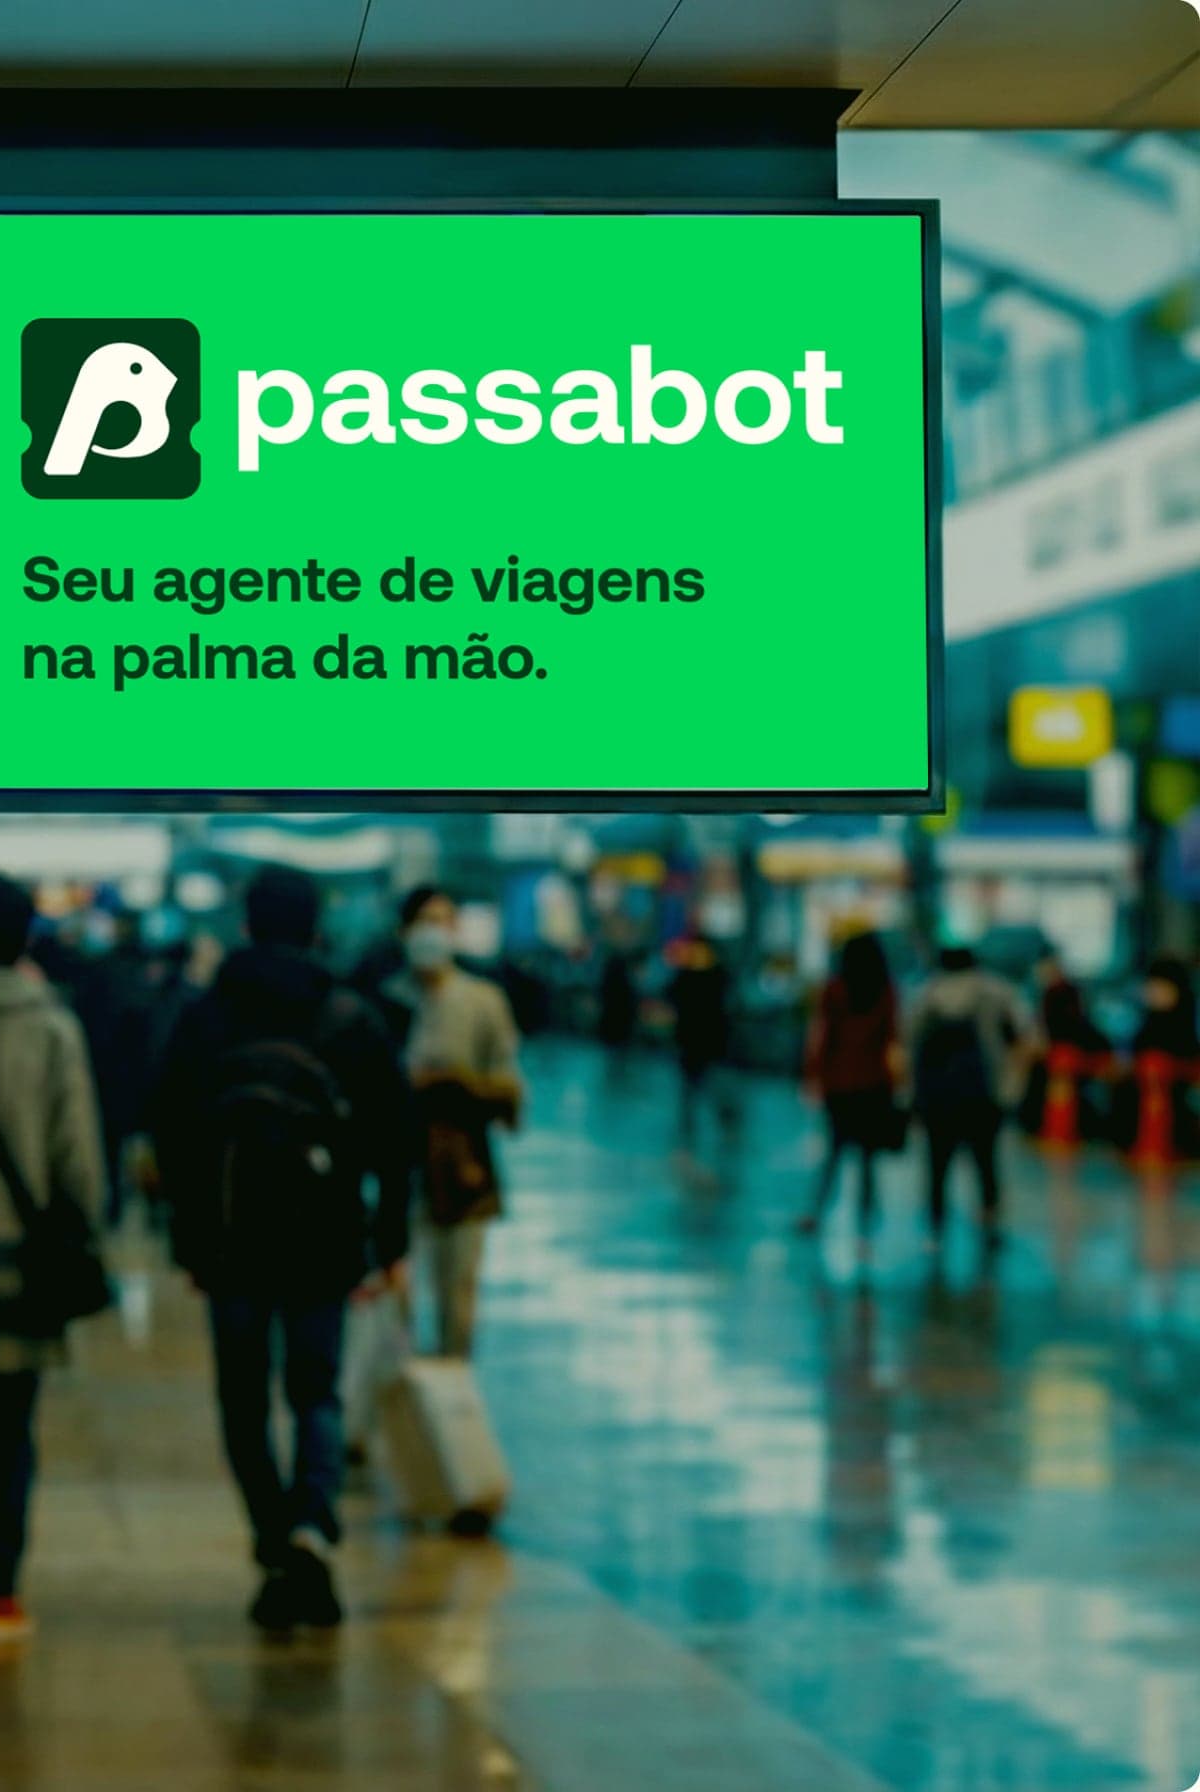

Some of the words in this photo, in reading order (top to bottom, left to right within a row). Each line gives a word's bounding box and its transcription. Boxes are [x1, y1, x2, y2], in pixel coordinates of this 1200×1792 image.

[238, 345, 843, 471] passabot
[24, 556, 133, 602] Seu
[154, 559, 361, 615] agente
[380, 557, 453, 602] de
[472, 555, 704, 615] viagens
[24, 645, 95, 679] na
[114, 634, 296, 691] palma
[314, 634, 387, 679] da
[406, 633, 547, 679] mão.
